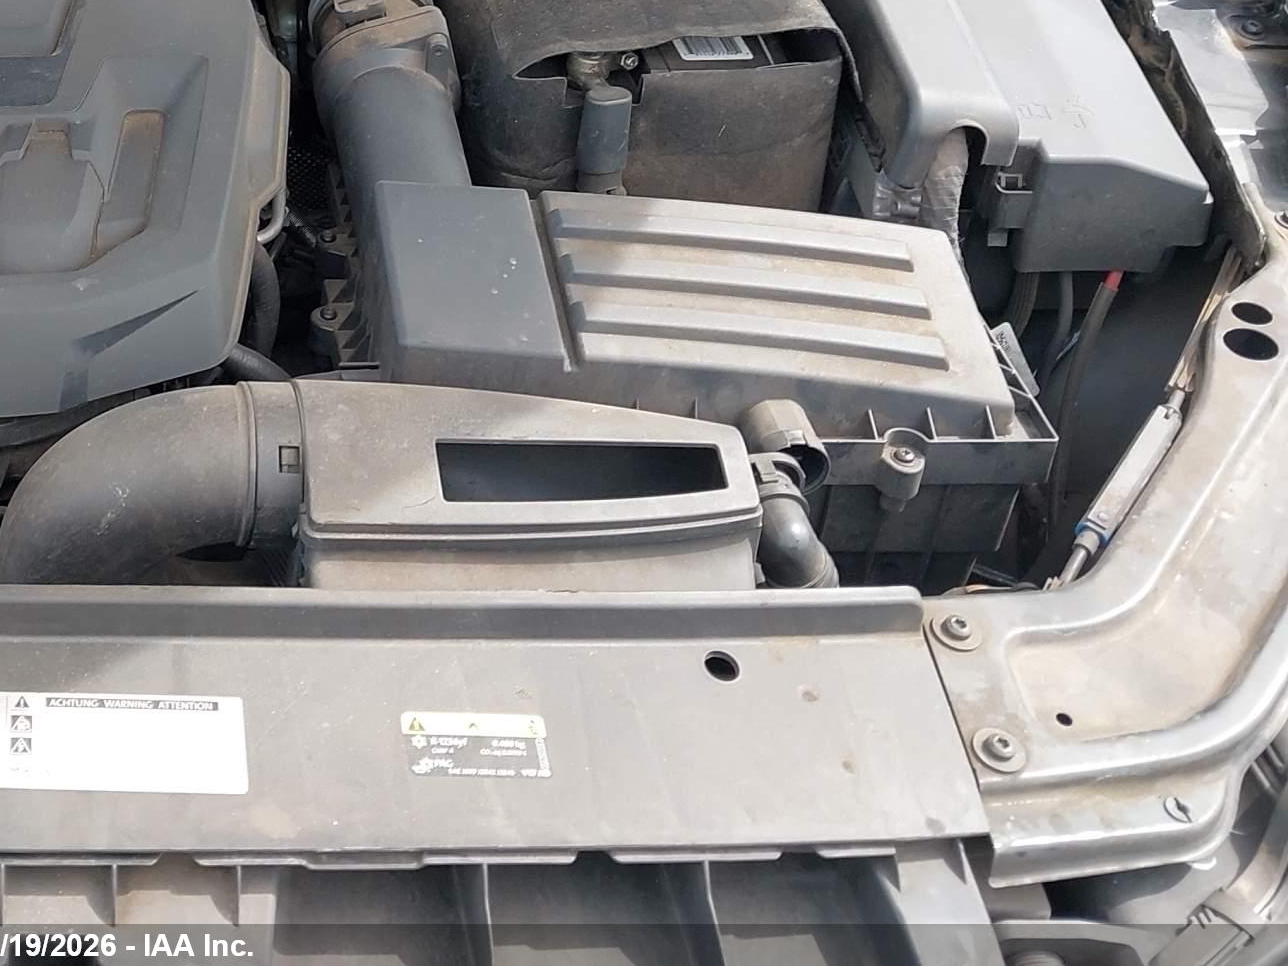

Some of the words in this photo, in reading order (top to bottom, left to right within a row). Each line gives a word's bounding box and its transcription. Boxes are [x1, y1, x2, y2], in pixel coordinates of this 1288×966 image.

[47, 697, 101, 708] ACHTUNG
[103, 698, 154, 709] WARNING
[158, 699, 215, 711] ATTENTION
